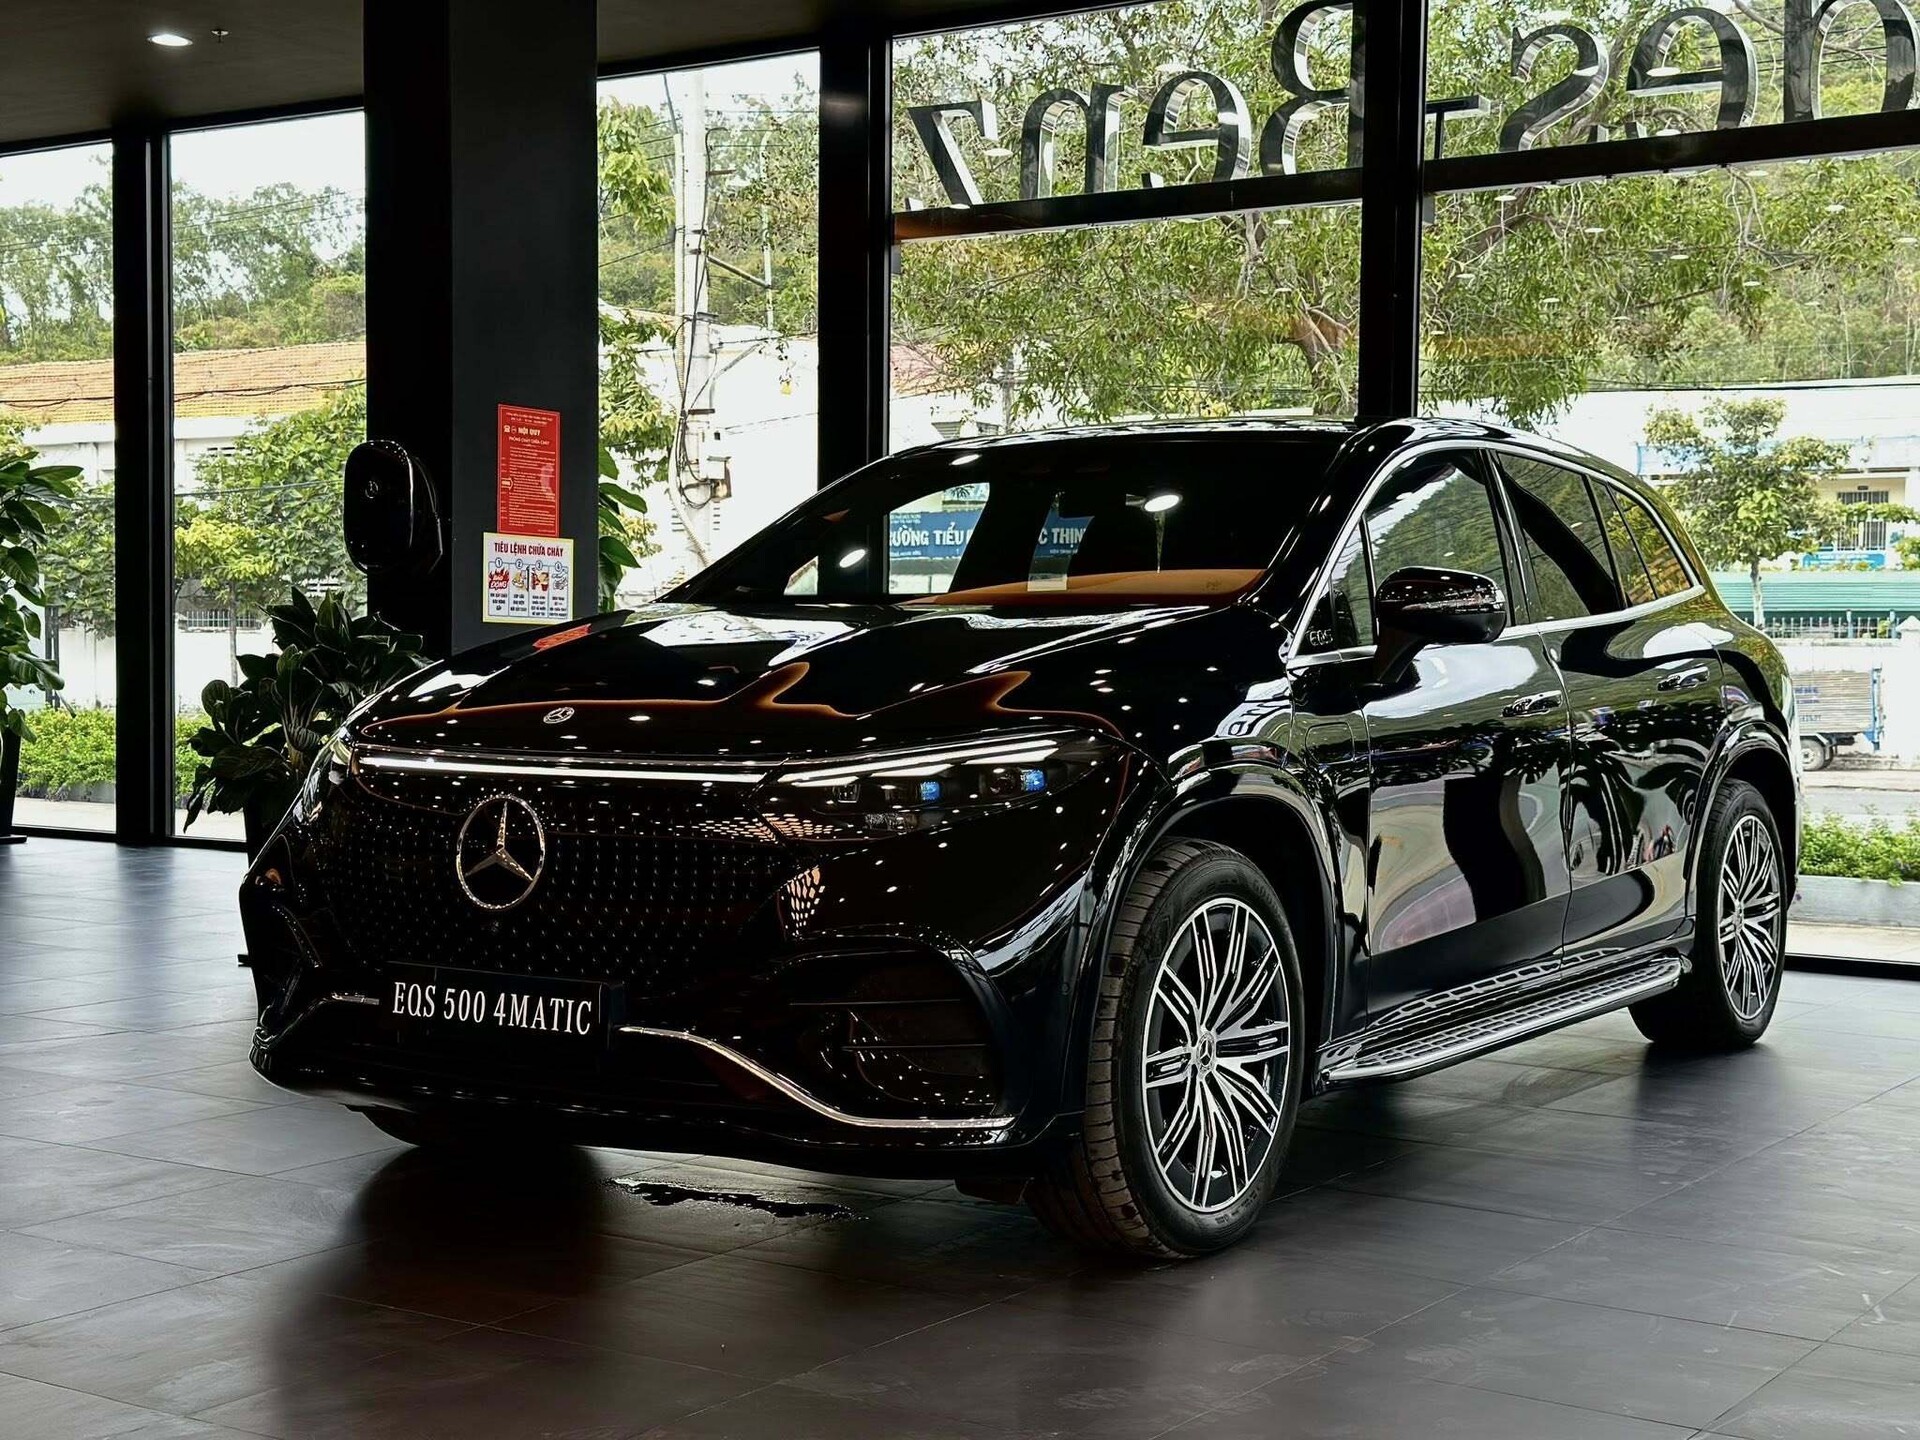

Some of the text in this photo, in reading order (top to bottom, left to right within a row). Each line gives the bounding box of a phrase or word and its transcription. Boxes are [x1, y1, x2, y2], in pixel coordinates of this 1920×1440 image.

[890, 524, 929, 547] ƯỜNG
[933, 522, 964, 546] TIỂU
[1051, 527, 1086, 548] THỊN
[495, 541, 564, 557] TIÊU LỆNH CHỮA CHÁY
[392, 981, 592, 1035] EQS 500 4MATIC
